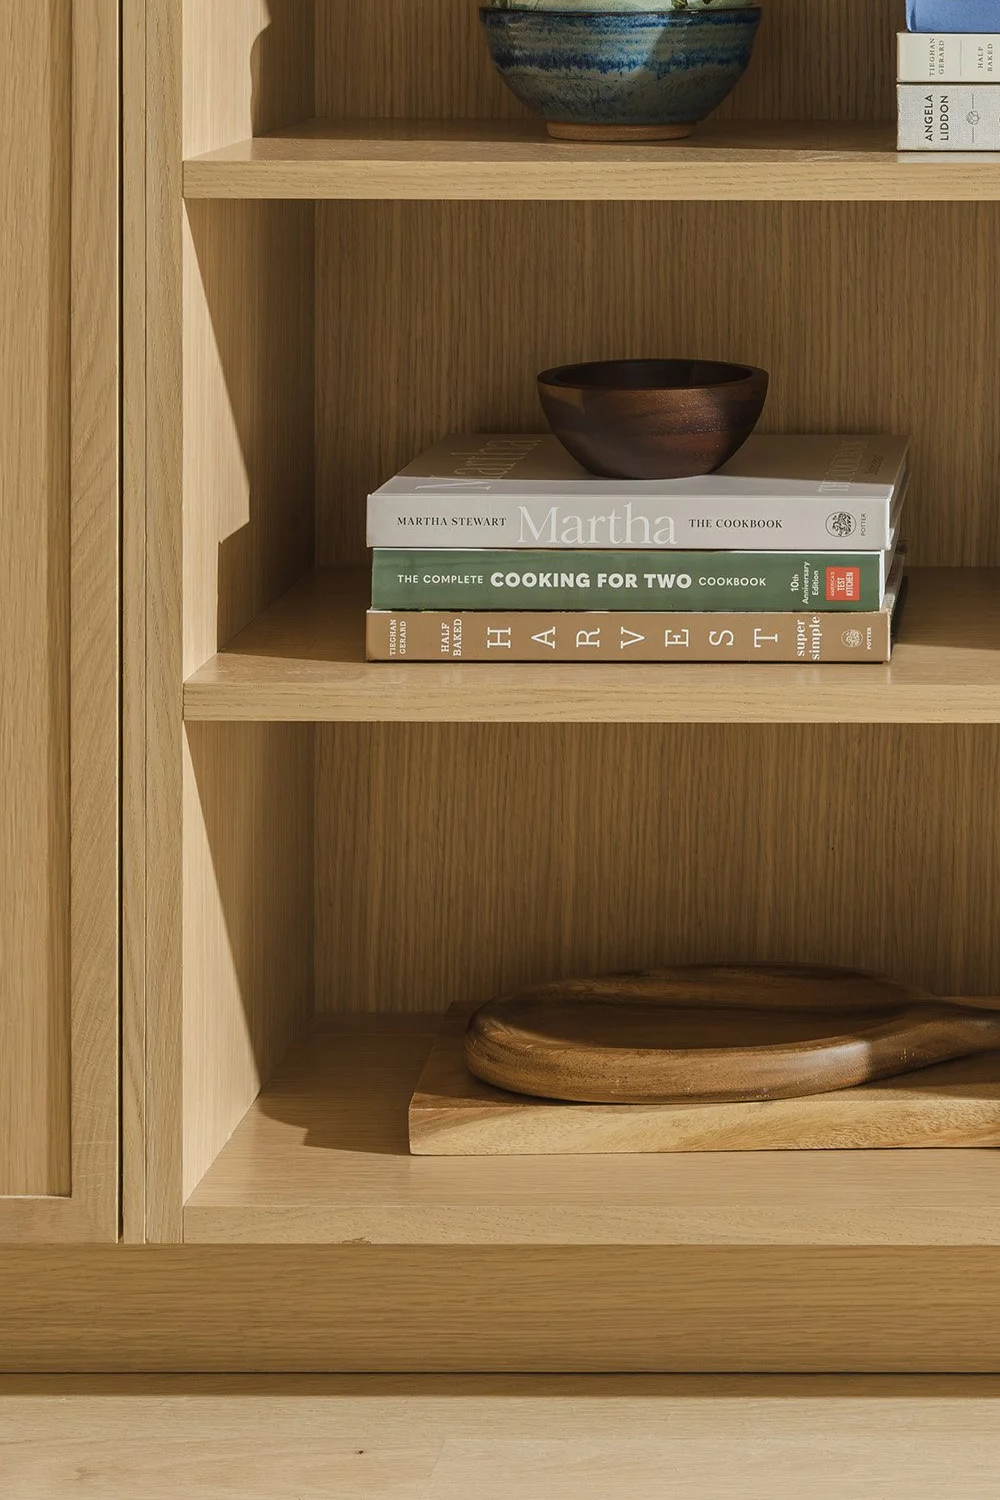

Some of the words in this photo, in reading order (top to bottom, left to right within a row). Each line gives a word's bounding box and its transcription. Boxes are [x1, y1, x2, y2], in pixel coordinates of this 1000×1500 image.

[924, 94, 934, 142] ANGELA
[939, 95, 949, 141] LIDDON
[397, 516, 448, 526] MARTHA
[451, 516, 507, 526] STEWART
[517, 500, 678, 545] Martha
[688, 518, 713, 529] THE
[715, 518, 783, 529] COOKBOOK
[397, 574, 419, 584] THE
[423, 574, 484, 585] COMPLETE
[490, 572, 591, 589] COOKING
[597, 573, 638, 589] FOR
[643, 573, 692, 589] TWO
[698, 576, 767, 587] COOKBOOK
[790, 573, 799, 592] 10th
[801, 561, 811, 605] Anniversary
[811, 570, 819, 596] Edition
[837, 577, 845, 591] TEST
[389, 619, 397, 656] TIEGHAN
[399, 620, 407, 654] GERARD
[441, 622, 450, 652] HALF
[453, 618, 462, 656] BAKED
[487, 626, 779, 649] HARVEST
[797, 619, 808, 657] super
[808, 616, 823, 660] simple
